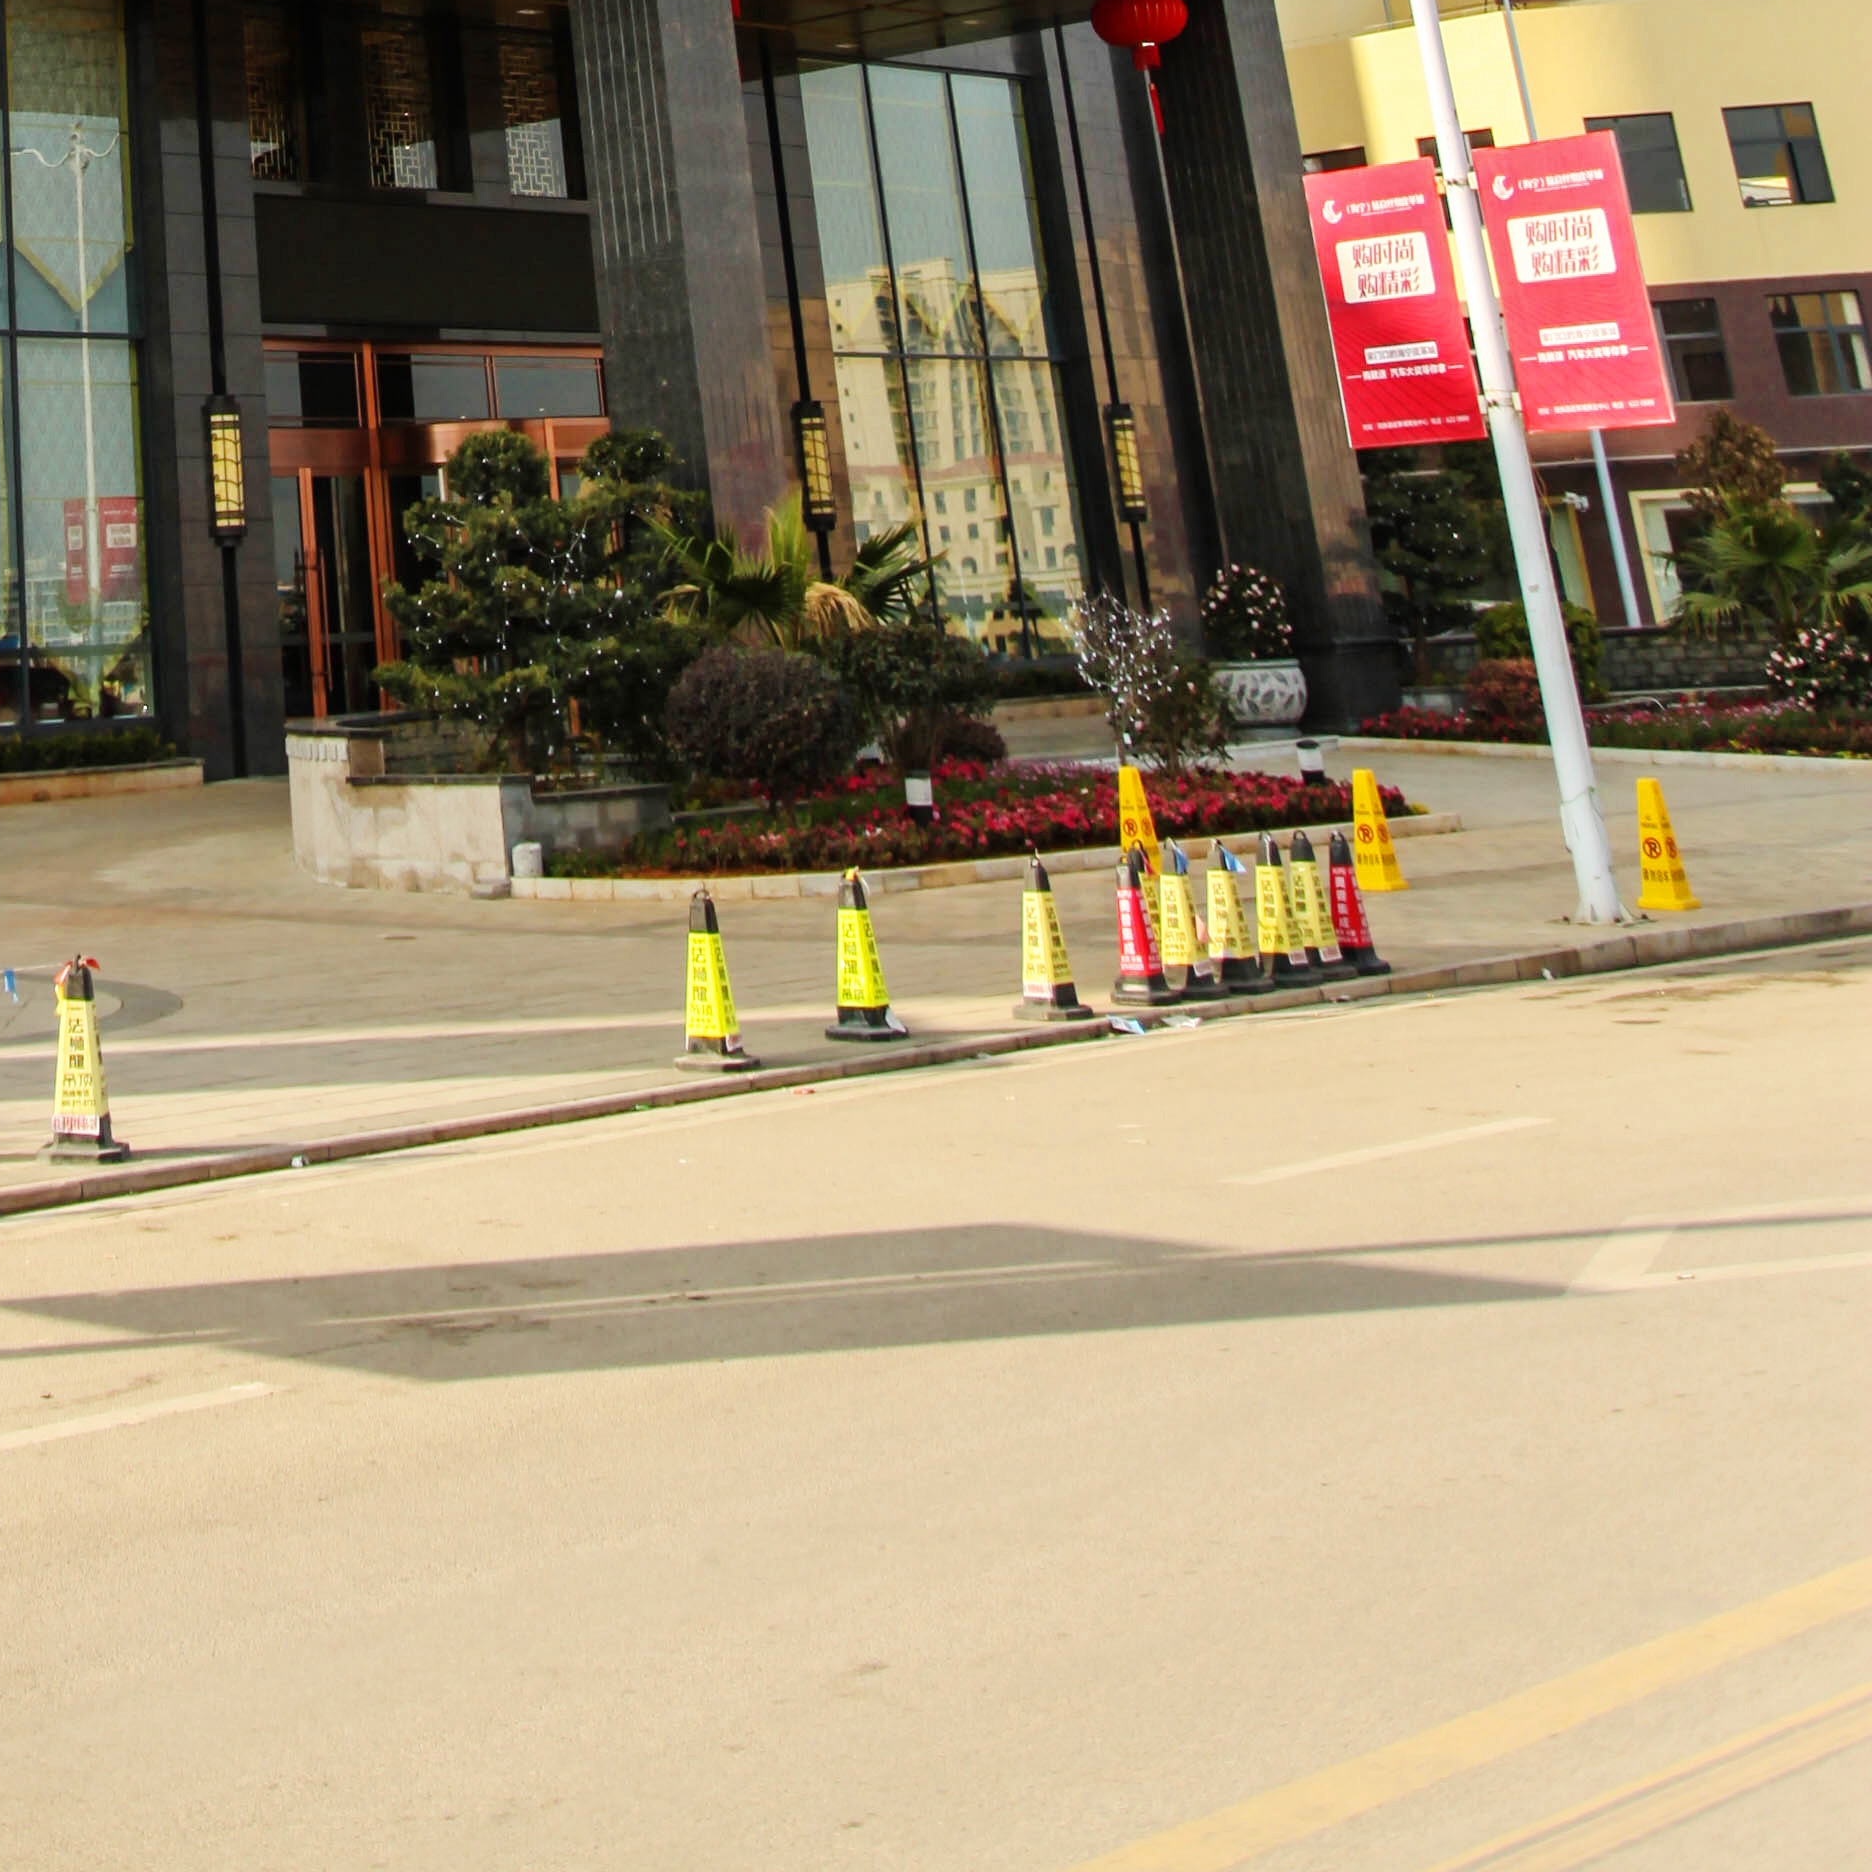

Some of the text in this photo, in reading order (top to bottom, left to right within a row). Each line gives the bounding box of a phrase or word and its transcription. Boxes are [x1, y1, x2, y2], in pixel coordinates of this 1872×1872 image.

[1524, 214, 1594, 247] 购时尚
[1352, 237, 1415, 269] 购时尚
[1531, 244, 1601, 278] 购精彩
[1357, 265, 1421, 299] 购精彩
